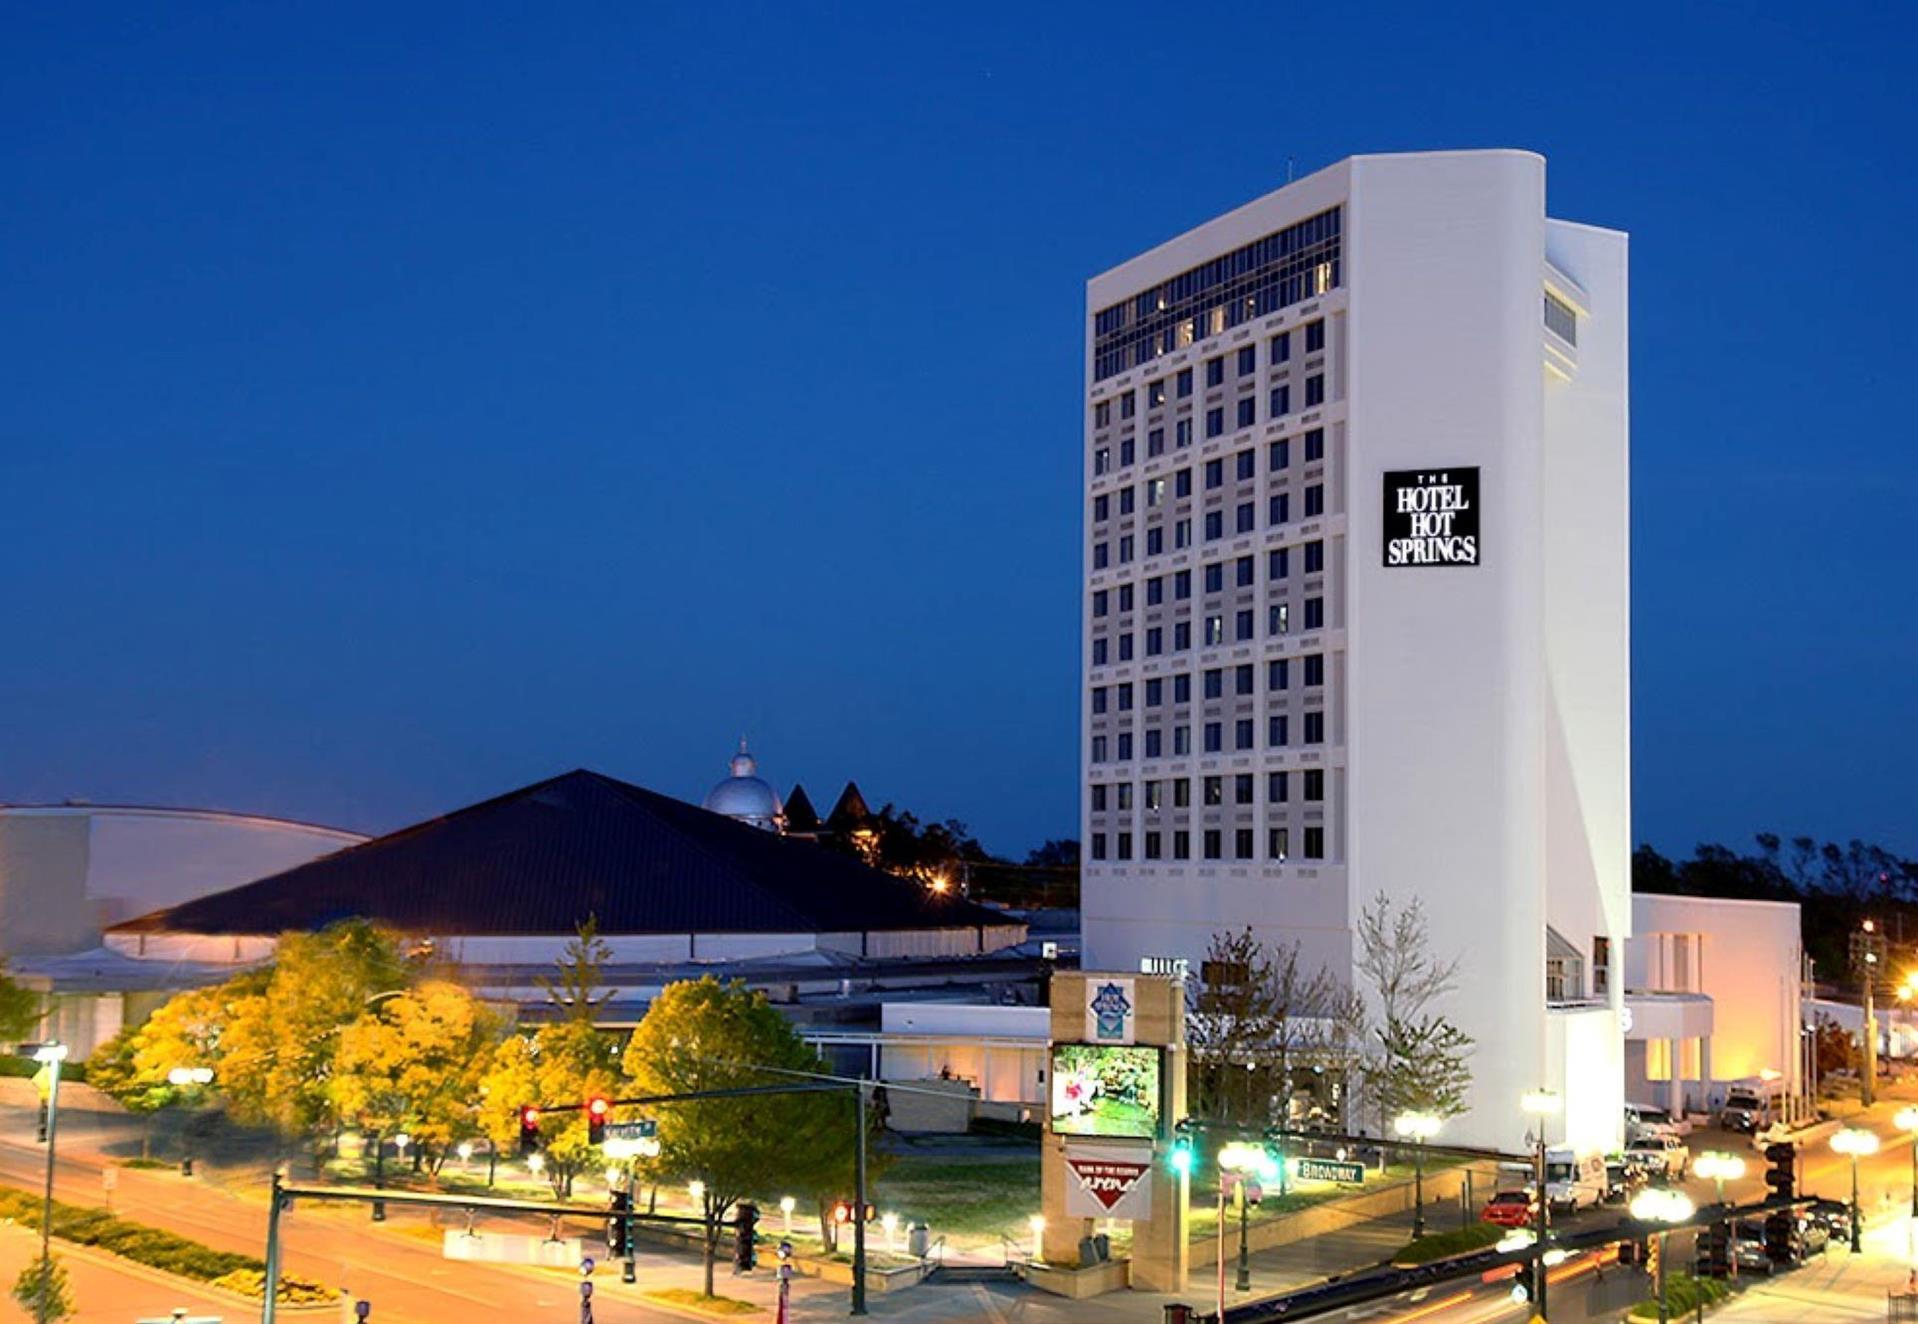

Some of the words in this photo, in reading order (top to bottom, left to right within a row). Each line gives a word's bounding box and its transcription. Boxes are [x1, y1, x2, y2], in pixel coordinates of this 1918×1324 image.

[1417, 473, 1449, 484] THE
[1396, 484, 1470, 513] HOTEL
[1410, 511, 1456, 538] HOT
[1388, 536, 1477, 564] SPRINGS
[1302, 1161, 1357, 1182] BROADWAY
